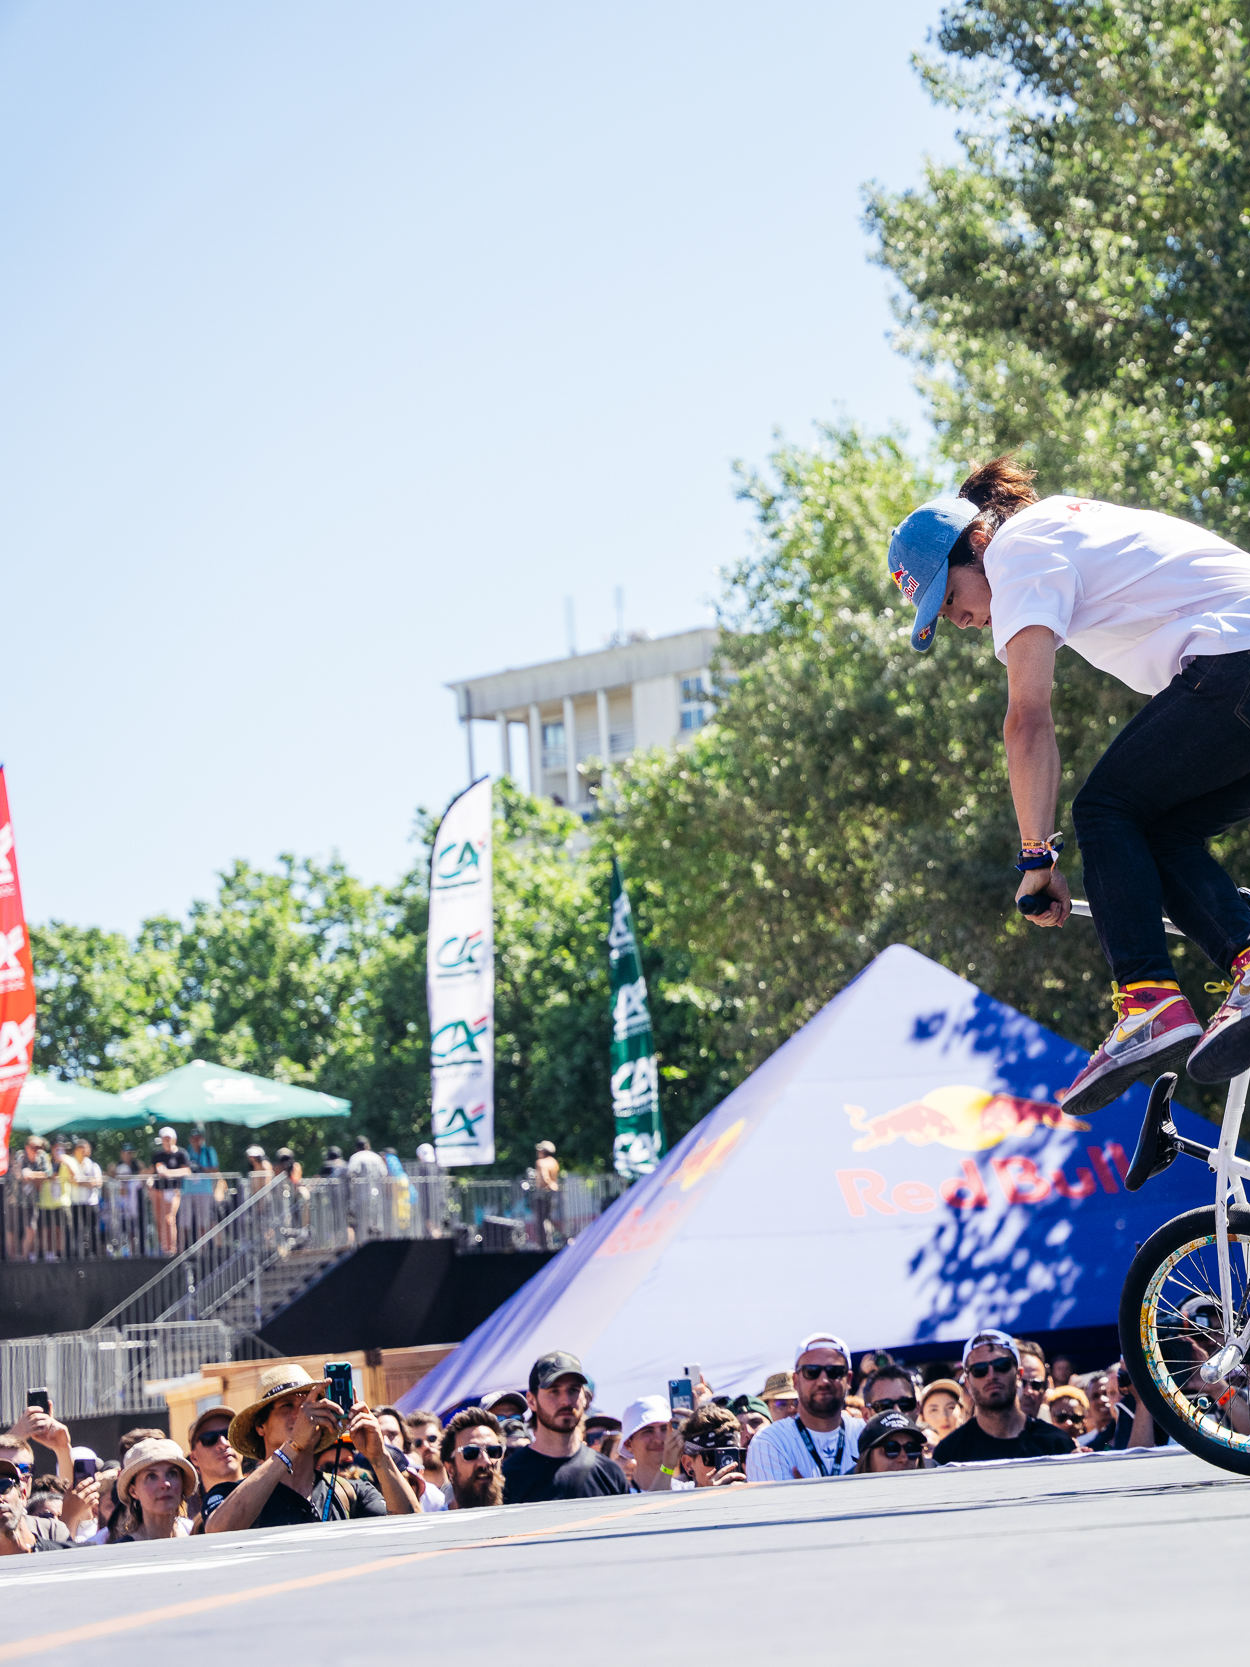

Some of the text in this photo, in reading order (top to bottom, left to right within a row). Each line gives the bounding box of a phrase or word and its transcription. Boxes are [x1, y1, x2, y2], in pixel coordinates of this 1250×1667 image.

[904, 575, 920, 598] Bull
[834, 1142, 1131, 1217] Red Bull
